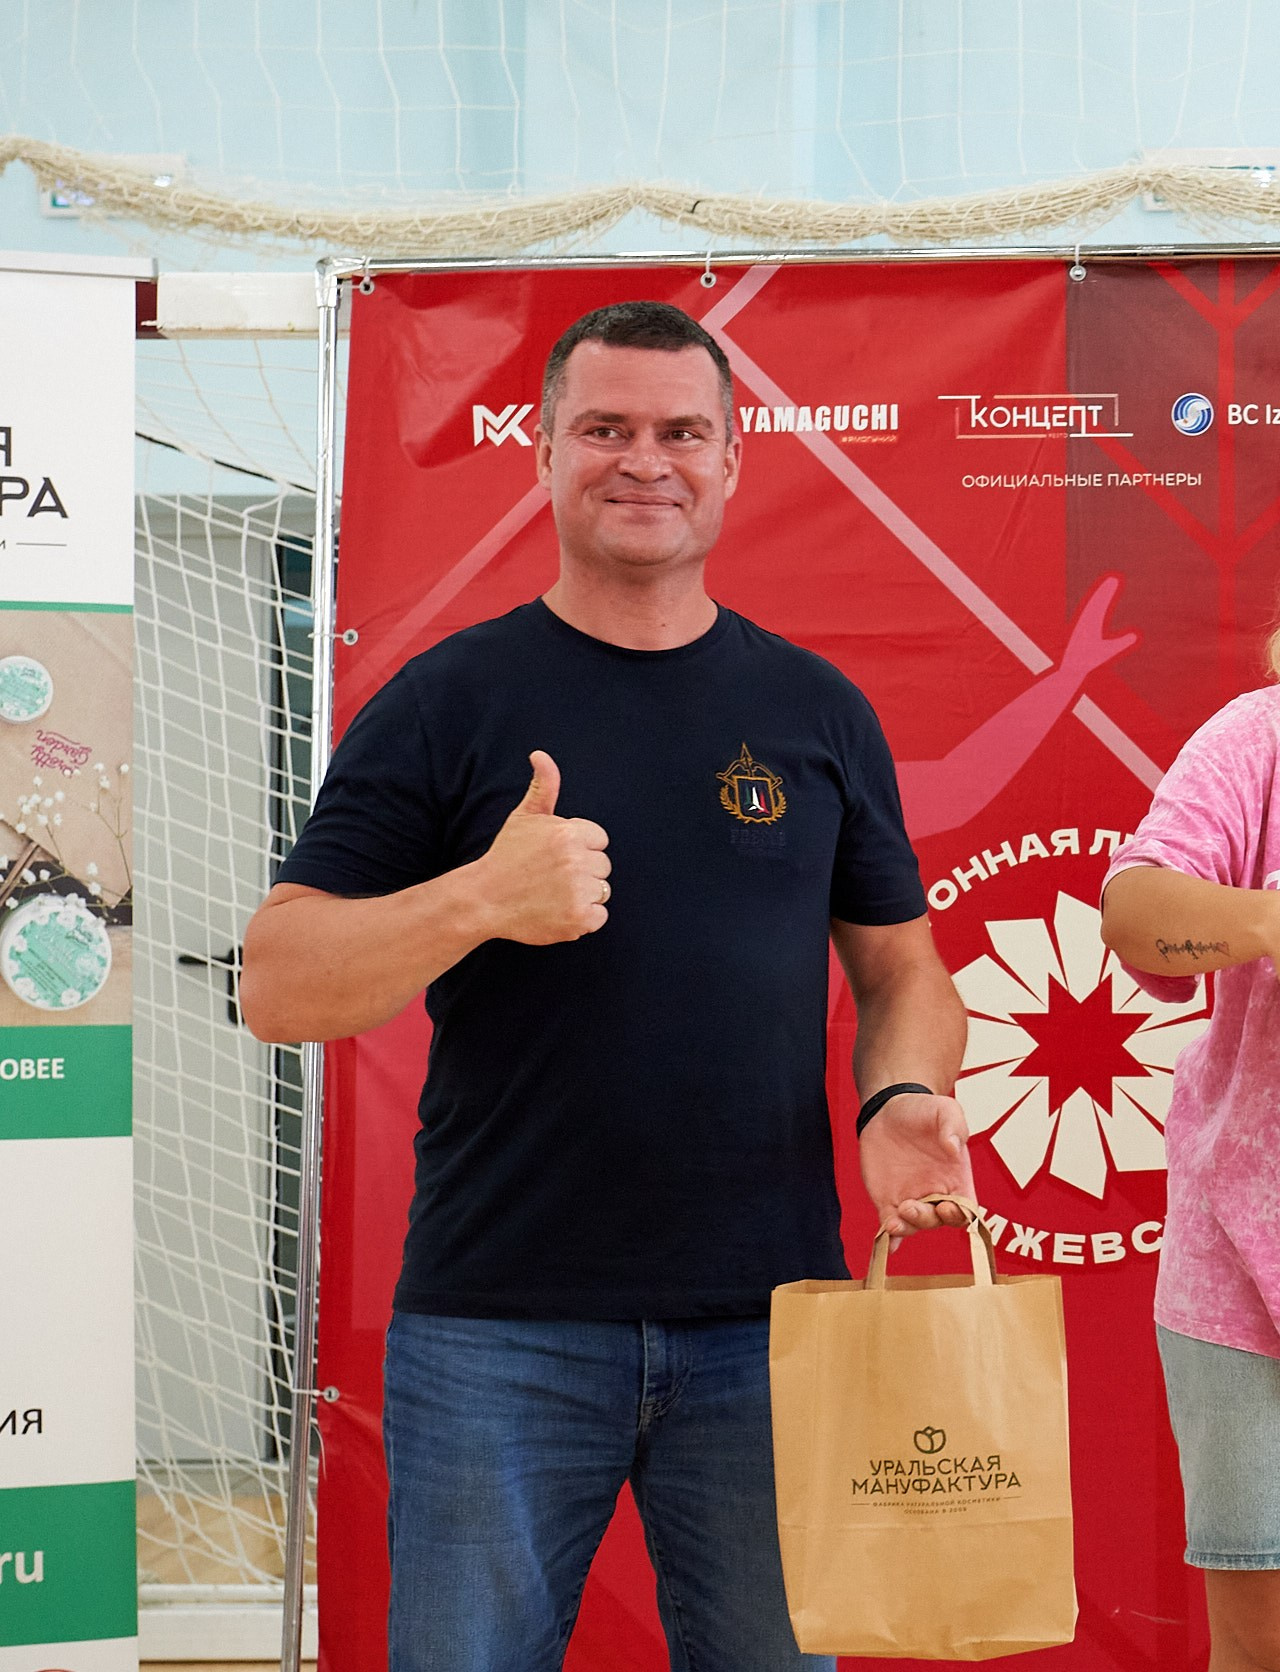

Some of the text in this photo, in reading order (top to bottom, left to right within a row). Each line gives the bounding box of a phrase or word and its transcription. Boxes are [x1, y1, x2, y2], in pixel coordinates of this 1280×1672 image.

[740, 403, 899, 433] YAMAGUCHI
[961, 472, 1202, 489] ОФИЦИАЛЬНЫЕ ПАРТНЕРЫ
[927, 828, 1135, 911] ОННАЯ Л
[979, 1206, 1168, 1265] ИЖЕВС
[870, 1455, 1001, 1476] УРАЛЬСКАЯ
[852, 1472, 1022, 1495] МАНУФАКТУРА
